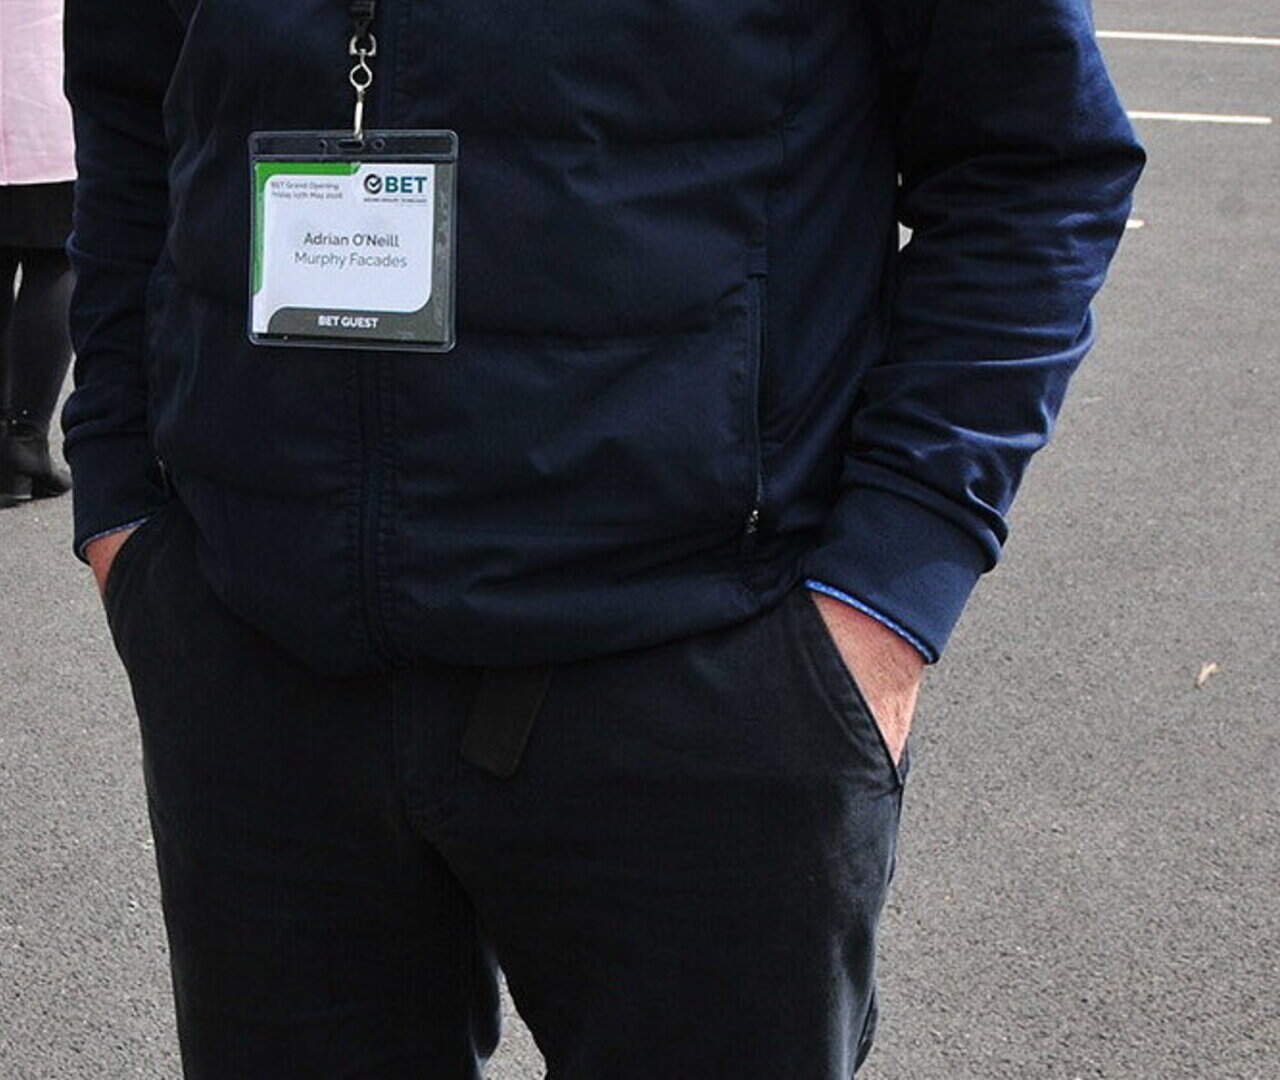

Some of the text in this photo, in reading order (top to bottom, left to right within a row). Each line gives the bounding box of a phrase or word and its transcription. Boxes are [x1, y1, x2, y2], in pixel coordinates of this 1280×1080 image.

[385, 175, 428, 194] BET
[304, 232, 400, 247] Adrian O'Neill
[294, 251, 408, 269] Murphy Facades
[318, 314, 379, 329] BET GUEST
